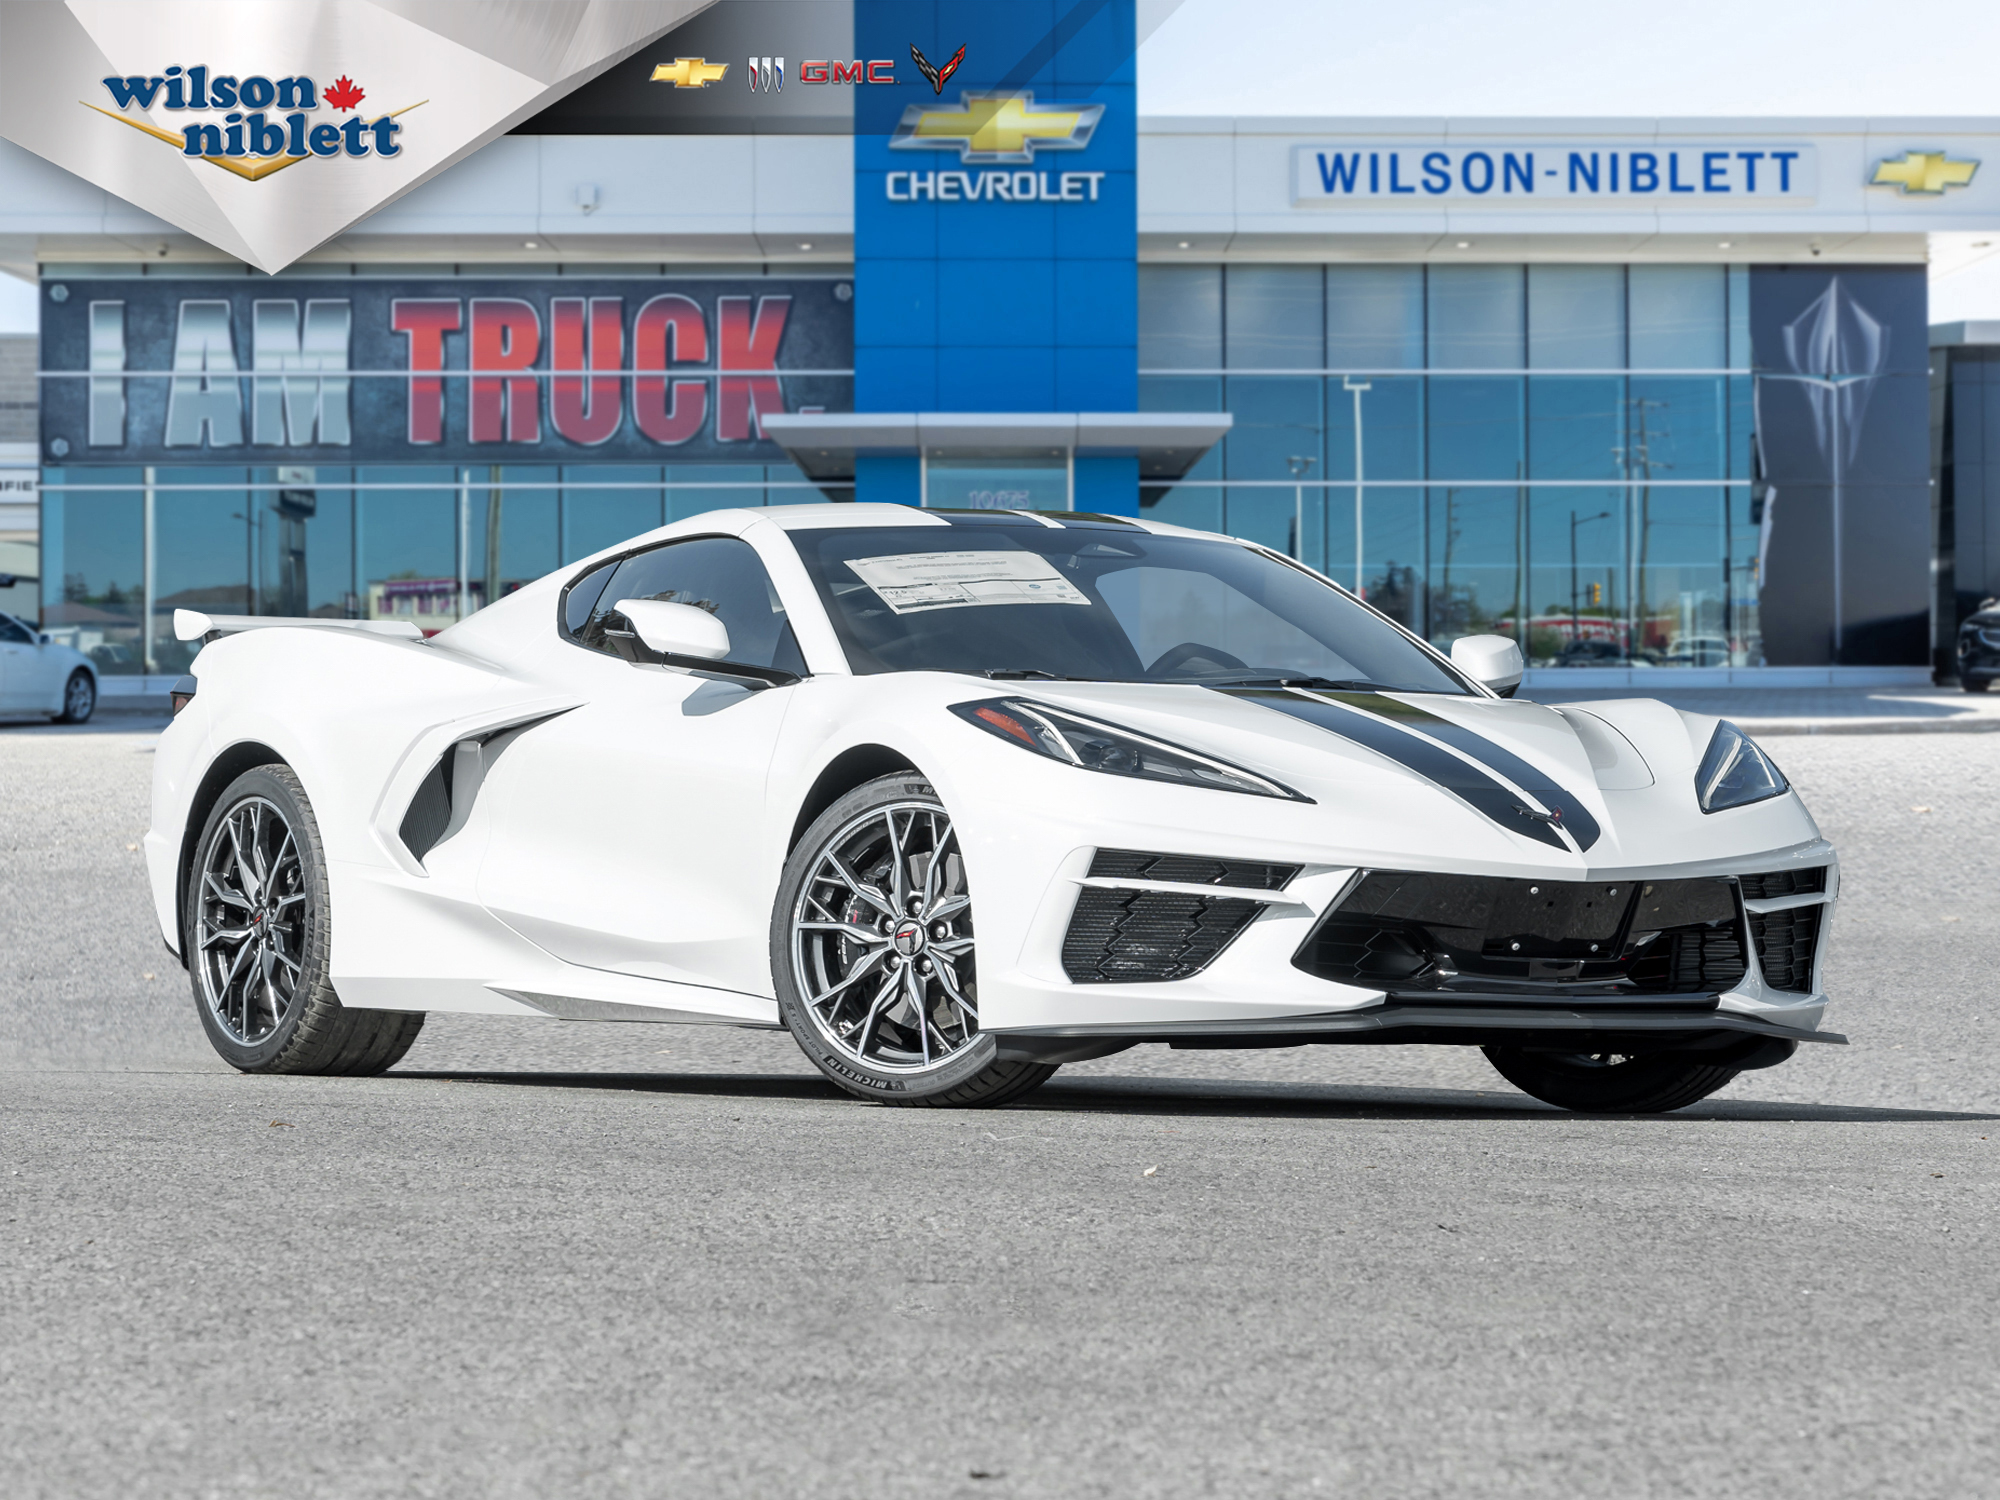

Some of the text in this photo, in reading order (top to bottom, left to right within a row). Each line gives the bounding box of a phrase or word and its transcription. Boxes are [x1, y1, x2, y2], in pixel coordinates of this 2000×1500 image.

[886, 171, 1106, 202] CHEVROLET
[1316, 151, 1799, 194] WILSON-NIBLETT
[88, 293, 793, 448] I AM TRUCK
[826, 1057, 889, 1090] MICHELIN
